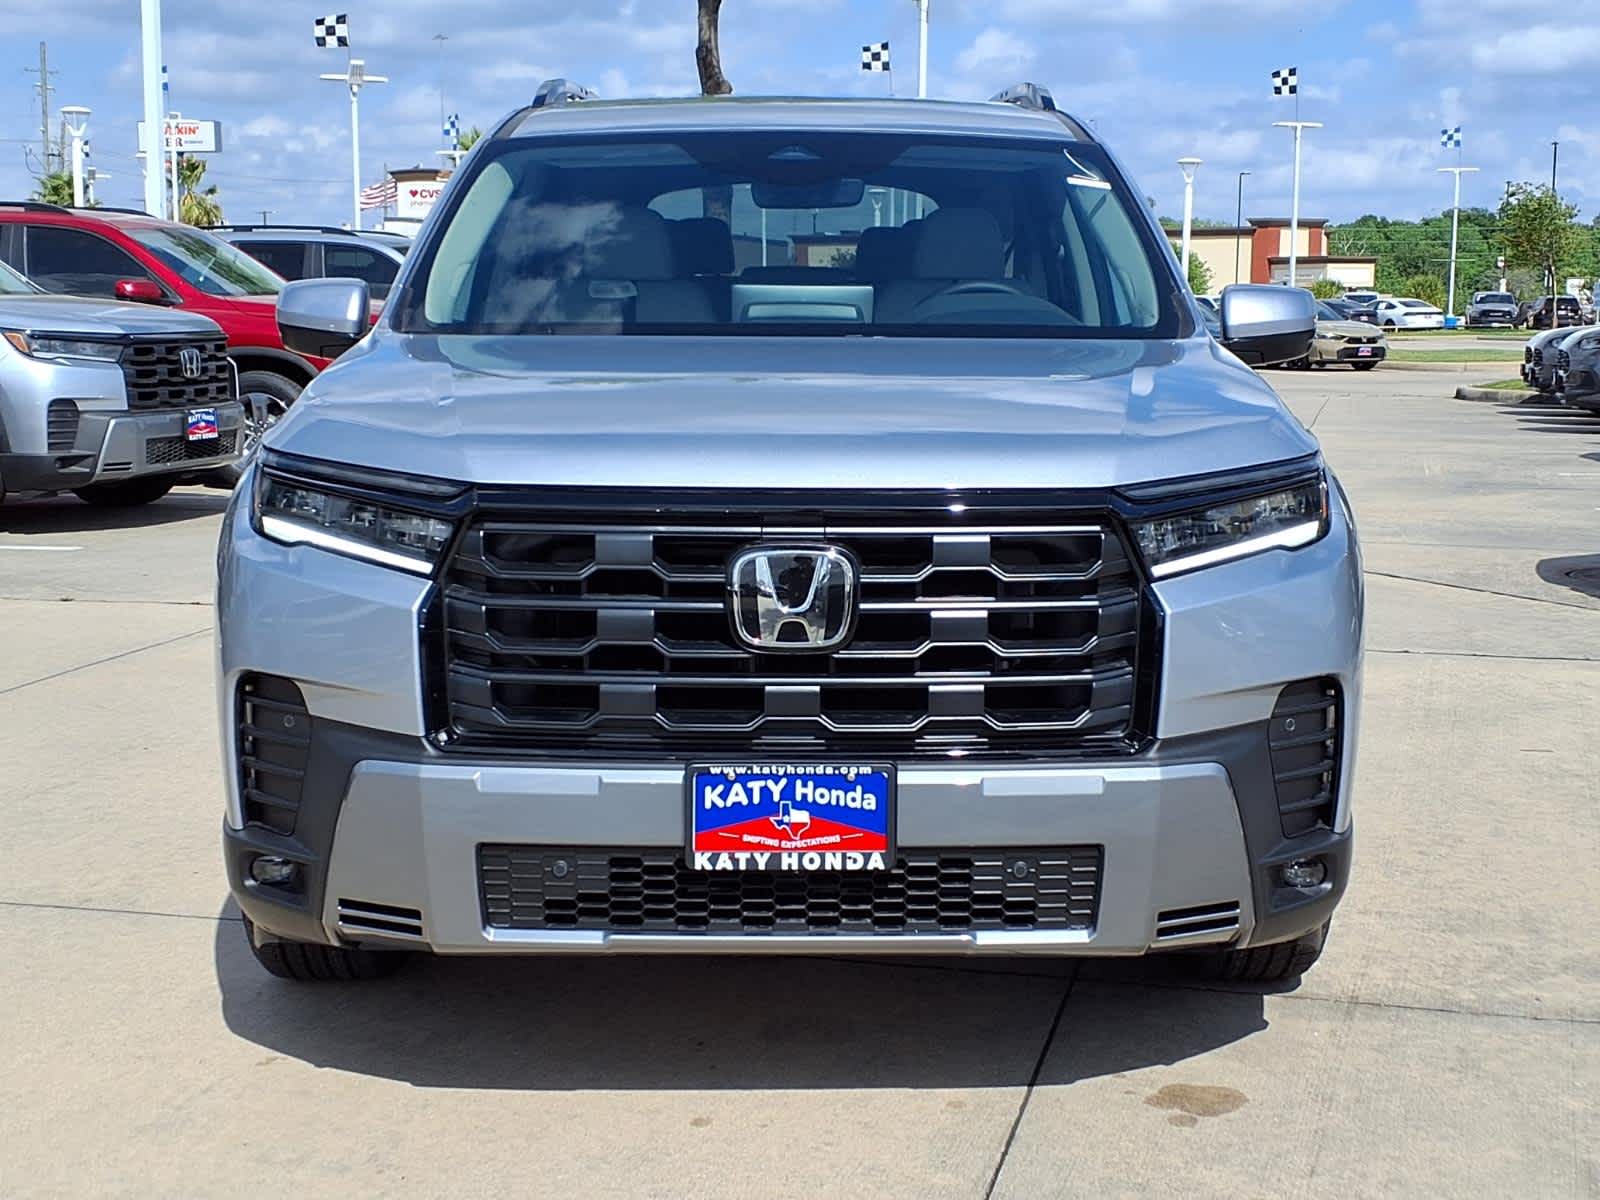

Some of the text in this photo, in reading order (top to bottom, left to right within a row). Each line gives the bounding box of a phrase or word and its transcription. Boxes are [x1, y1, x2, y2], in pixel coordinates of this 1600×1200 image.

[709, 764, 872, 776] www.katyhonda.com
[704, 777, 877, 811] KATY Honda
[742, 833, 841, 849] SHIFTING EXPECTATIONS
[694, 852, 886, 871] KATY HONDA
